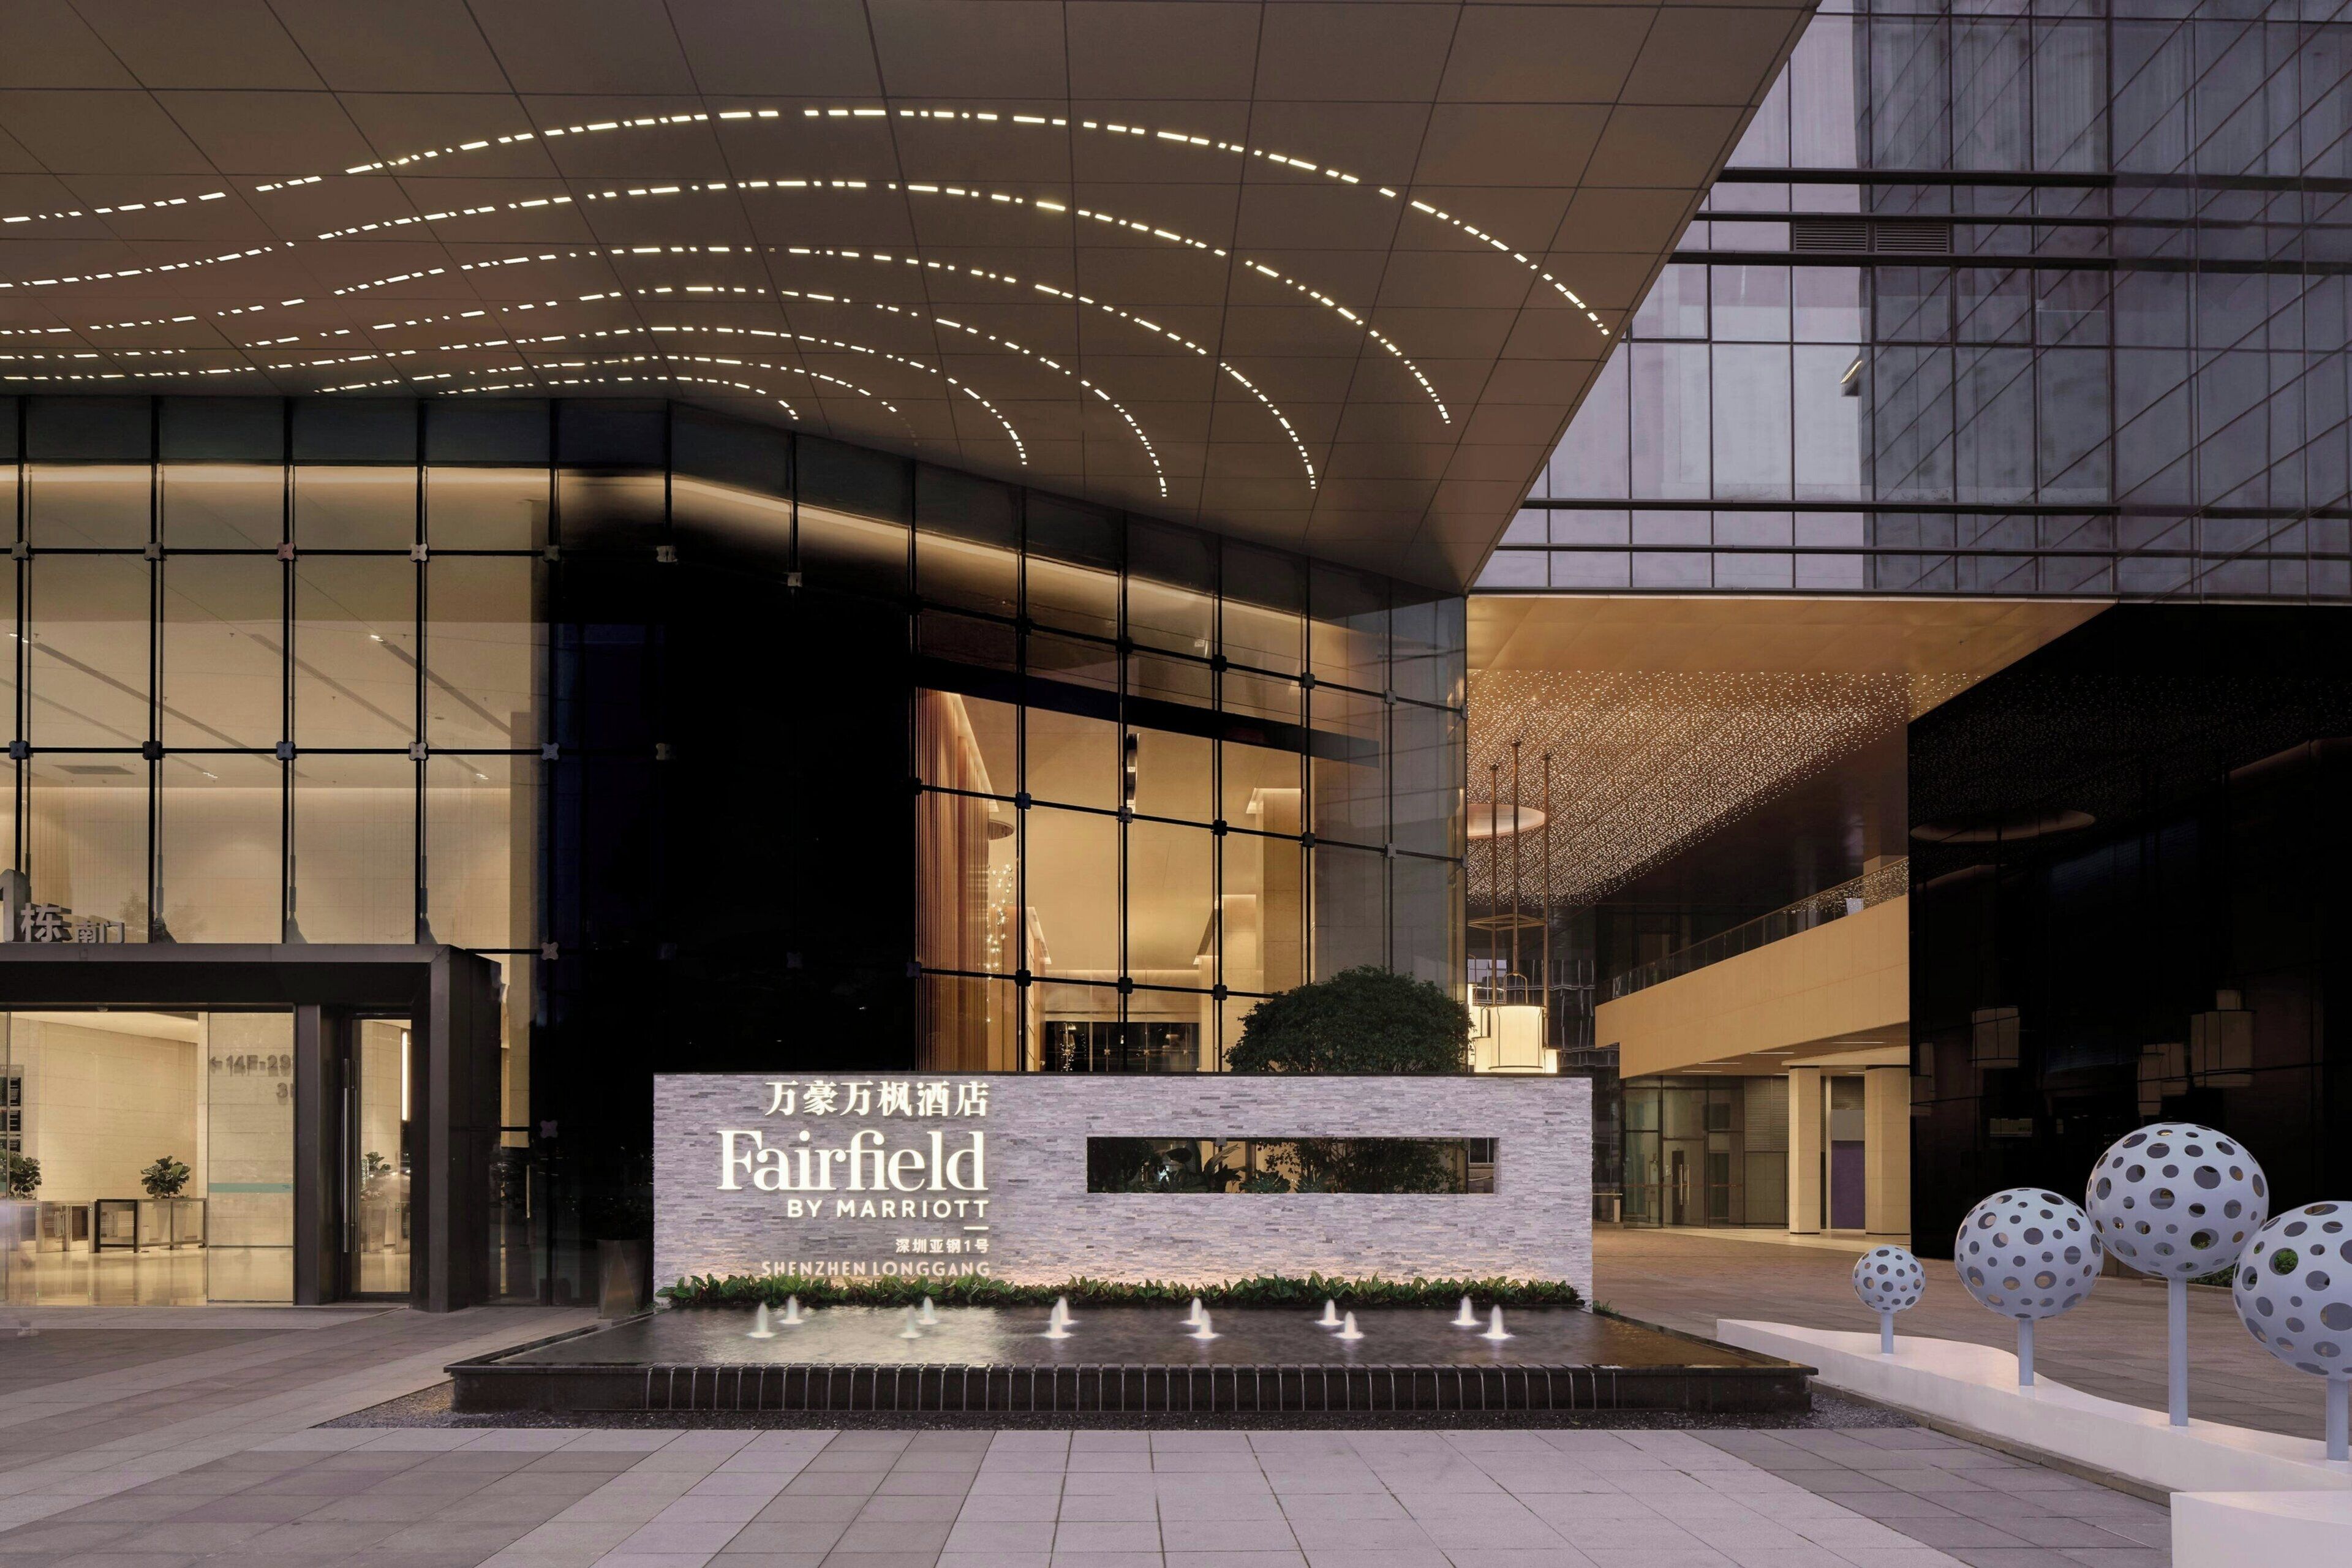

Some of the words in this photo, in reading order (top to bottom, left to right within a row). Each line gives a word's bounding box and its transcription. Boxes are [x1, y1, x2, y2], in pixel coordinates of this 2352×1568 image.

[765, 1080, 989, 1116] 万豪万枫酒店
[716, 1130, 989, 1191] Fairfield
[788, 1200, 822, 1218] BY
[837, 1200, 989, 1218] MARRIOTT
[761, 1261, 865, 1276] SHENZHEN
[873, 1261, 990, 1276] LONGGANG
